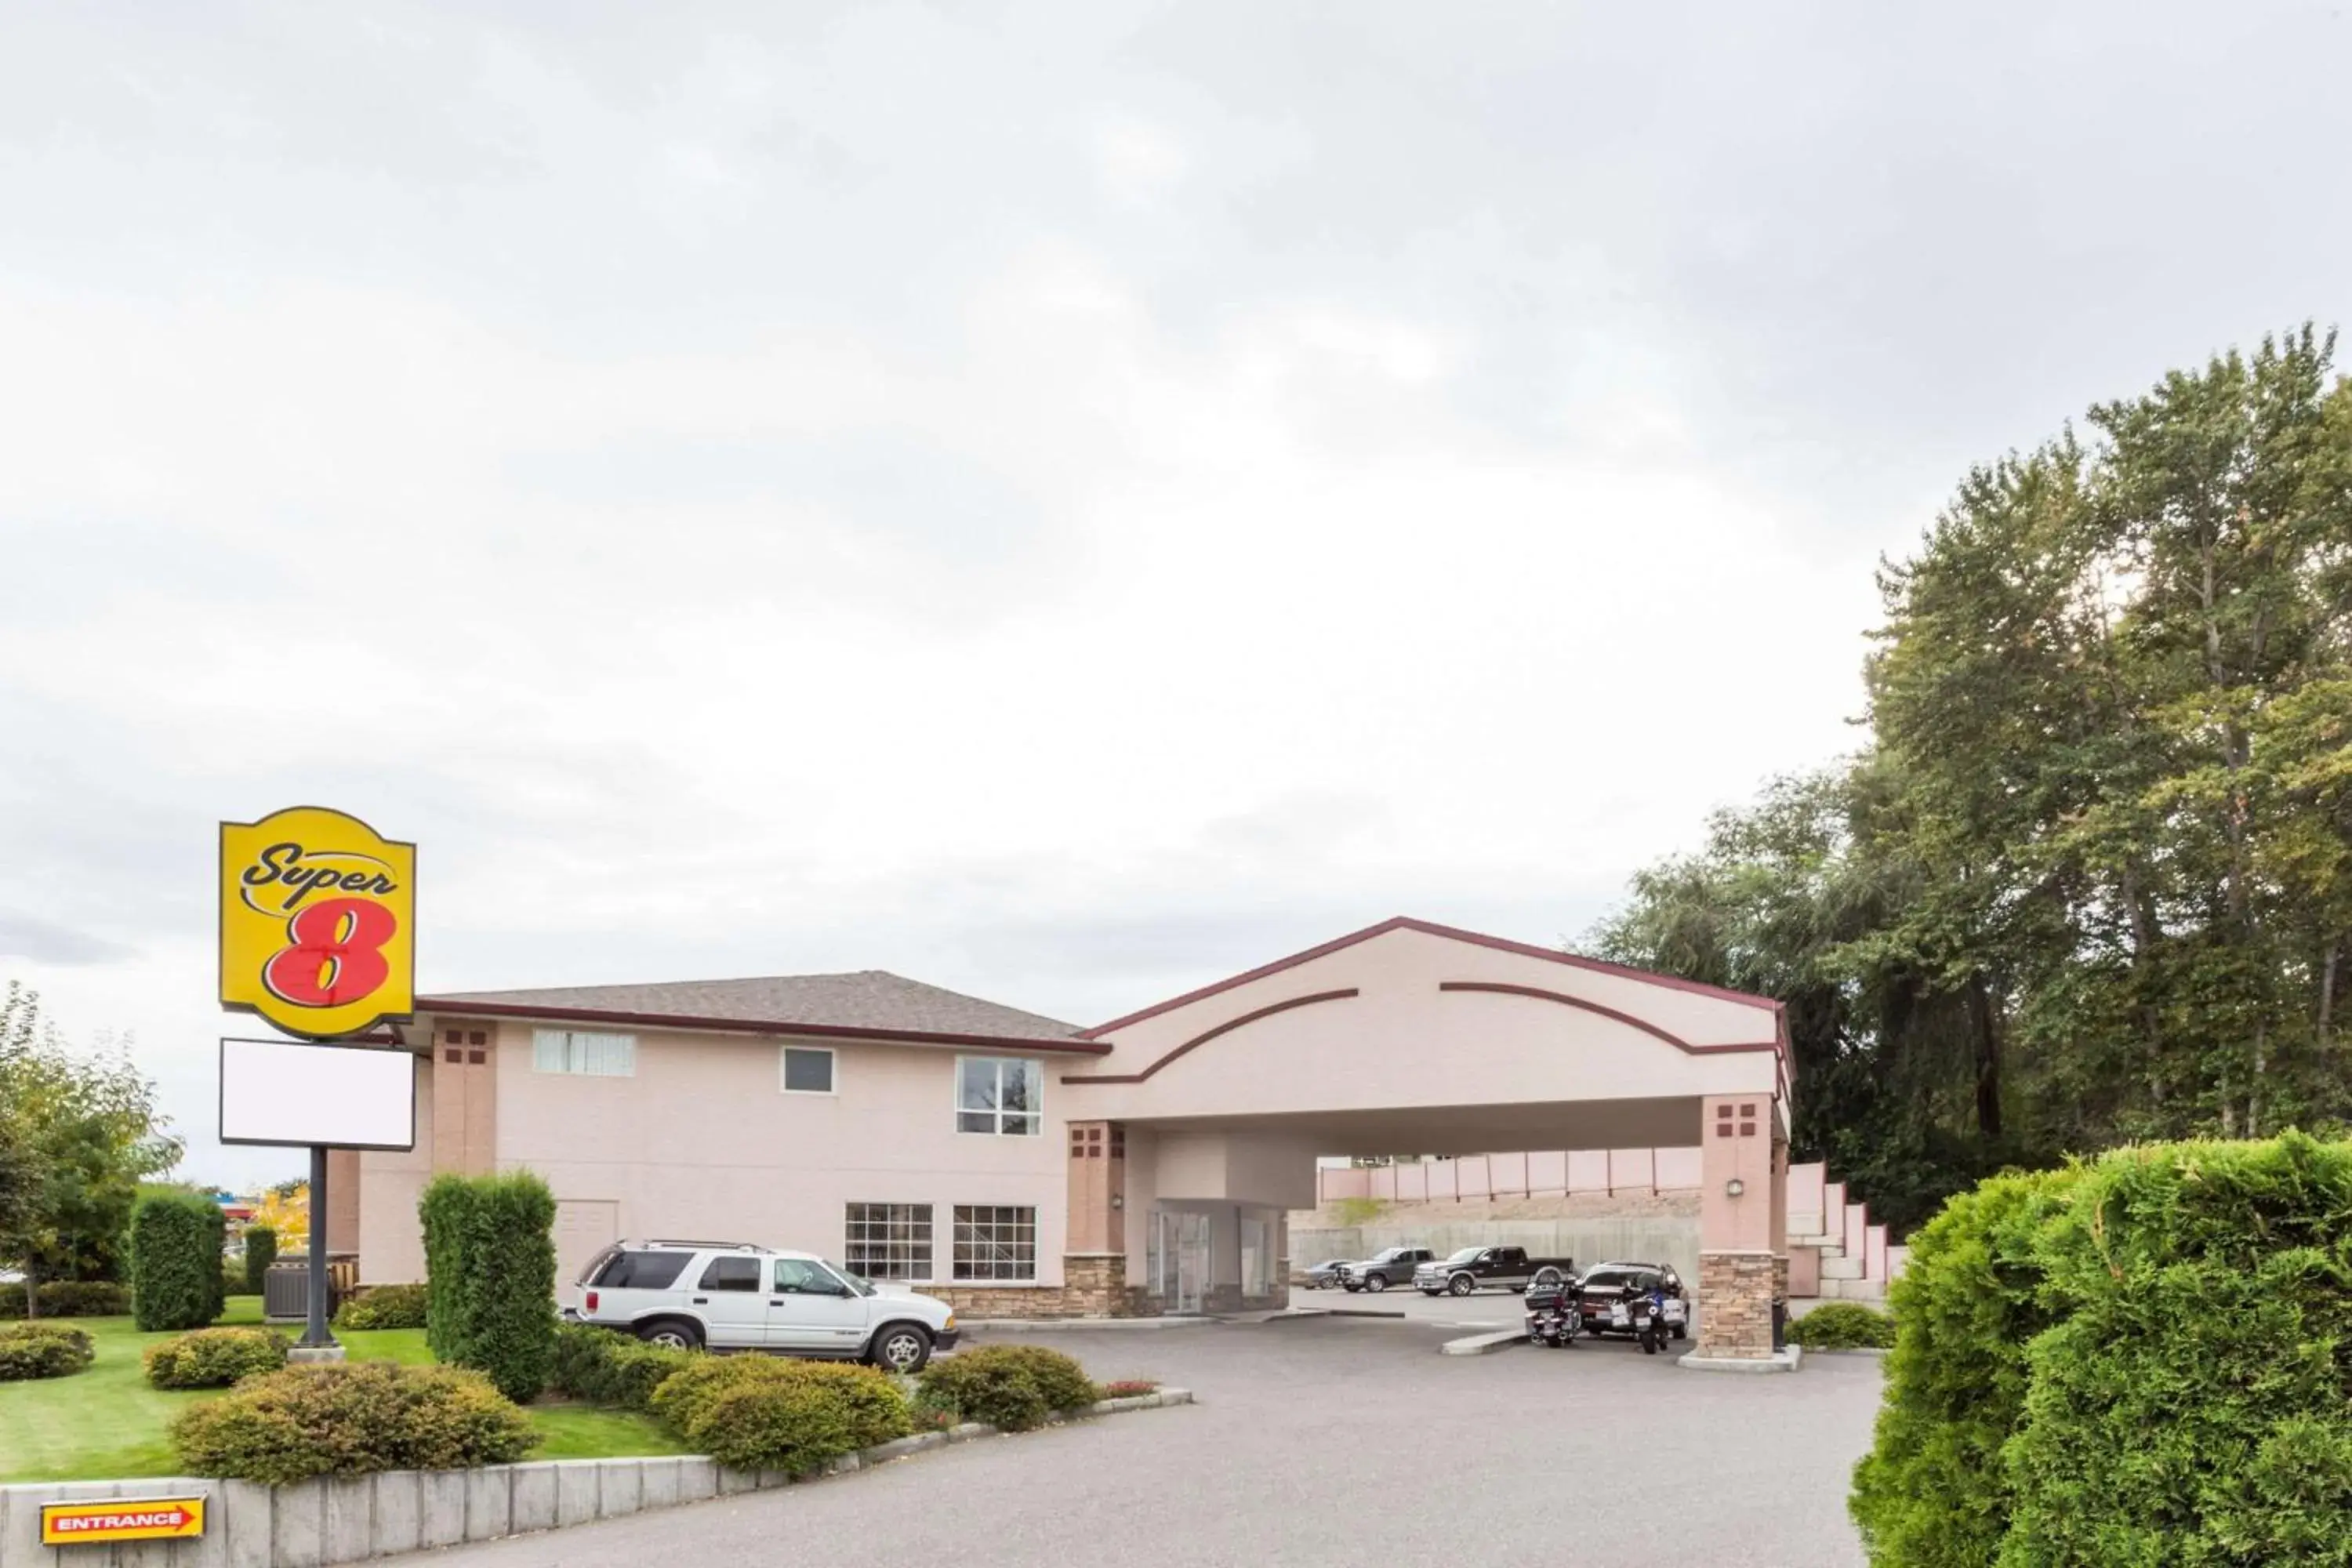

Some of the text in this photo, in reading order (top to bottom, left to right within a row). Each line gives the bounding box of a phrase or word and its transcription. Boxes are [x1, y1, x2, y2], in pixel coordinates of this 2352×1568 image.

[242, 843, 398, 910] Super
[262, 897, 397, 1008] 8
[57, 1512, 182, 1530] ENTRANCE
